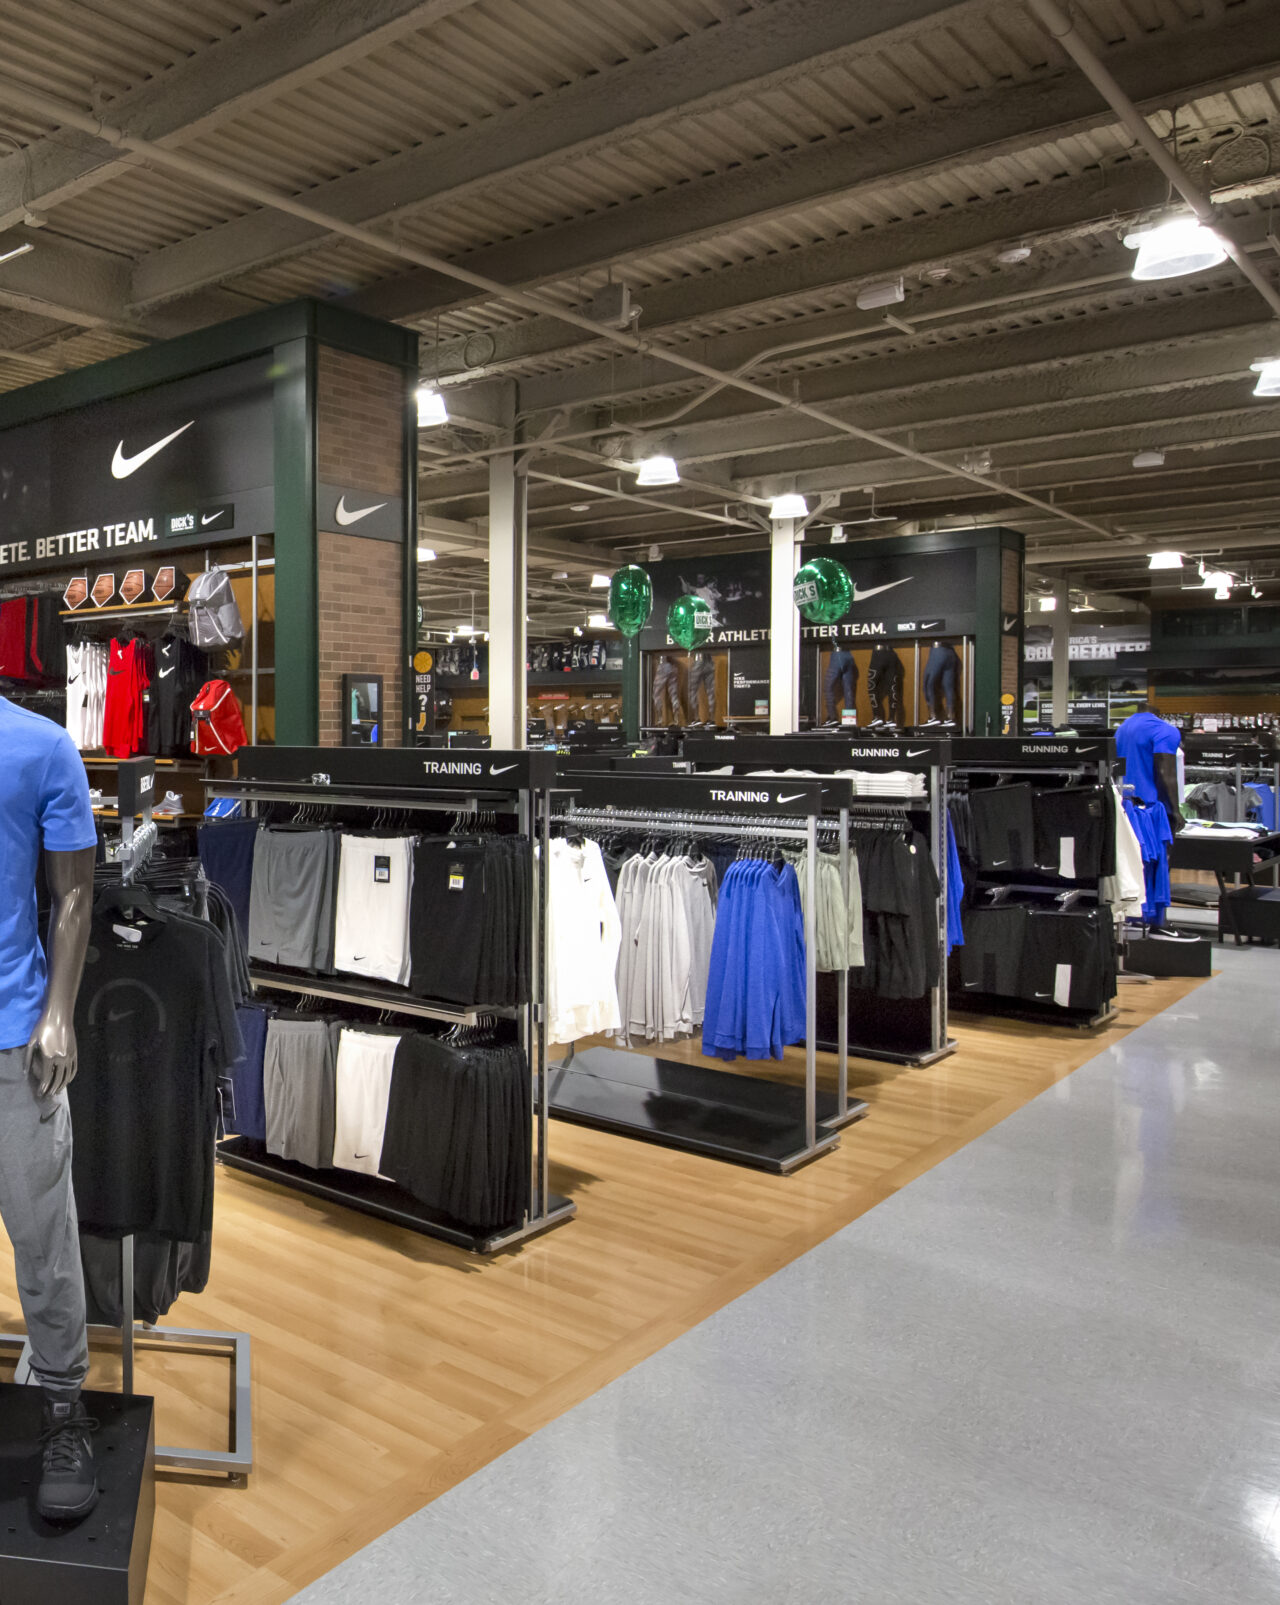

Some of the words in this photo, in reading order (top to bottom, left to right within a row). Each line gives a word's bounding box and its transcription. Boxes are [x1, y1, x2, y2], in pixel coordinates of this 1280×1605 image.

[171, 513, 194, 529] DICK'S
[35, 527, 99, 559] BETTER
[103, 518, 158, 547] TEAM.
[841, 621, 887, 637] TEAM.
[1024, 645, 1054, 661] GOL
[415, 674, 431, 683] NEED
[415, 684, 431, 693] HELP
[418, 694, 428, 711] ?
[851, 748, 899, 758] RUNNING
[1021, 745, 1069, 754] RUNNING
[423, 761, 482, 775] TRAINING
[709, 789, 770, 803] TRAINING
